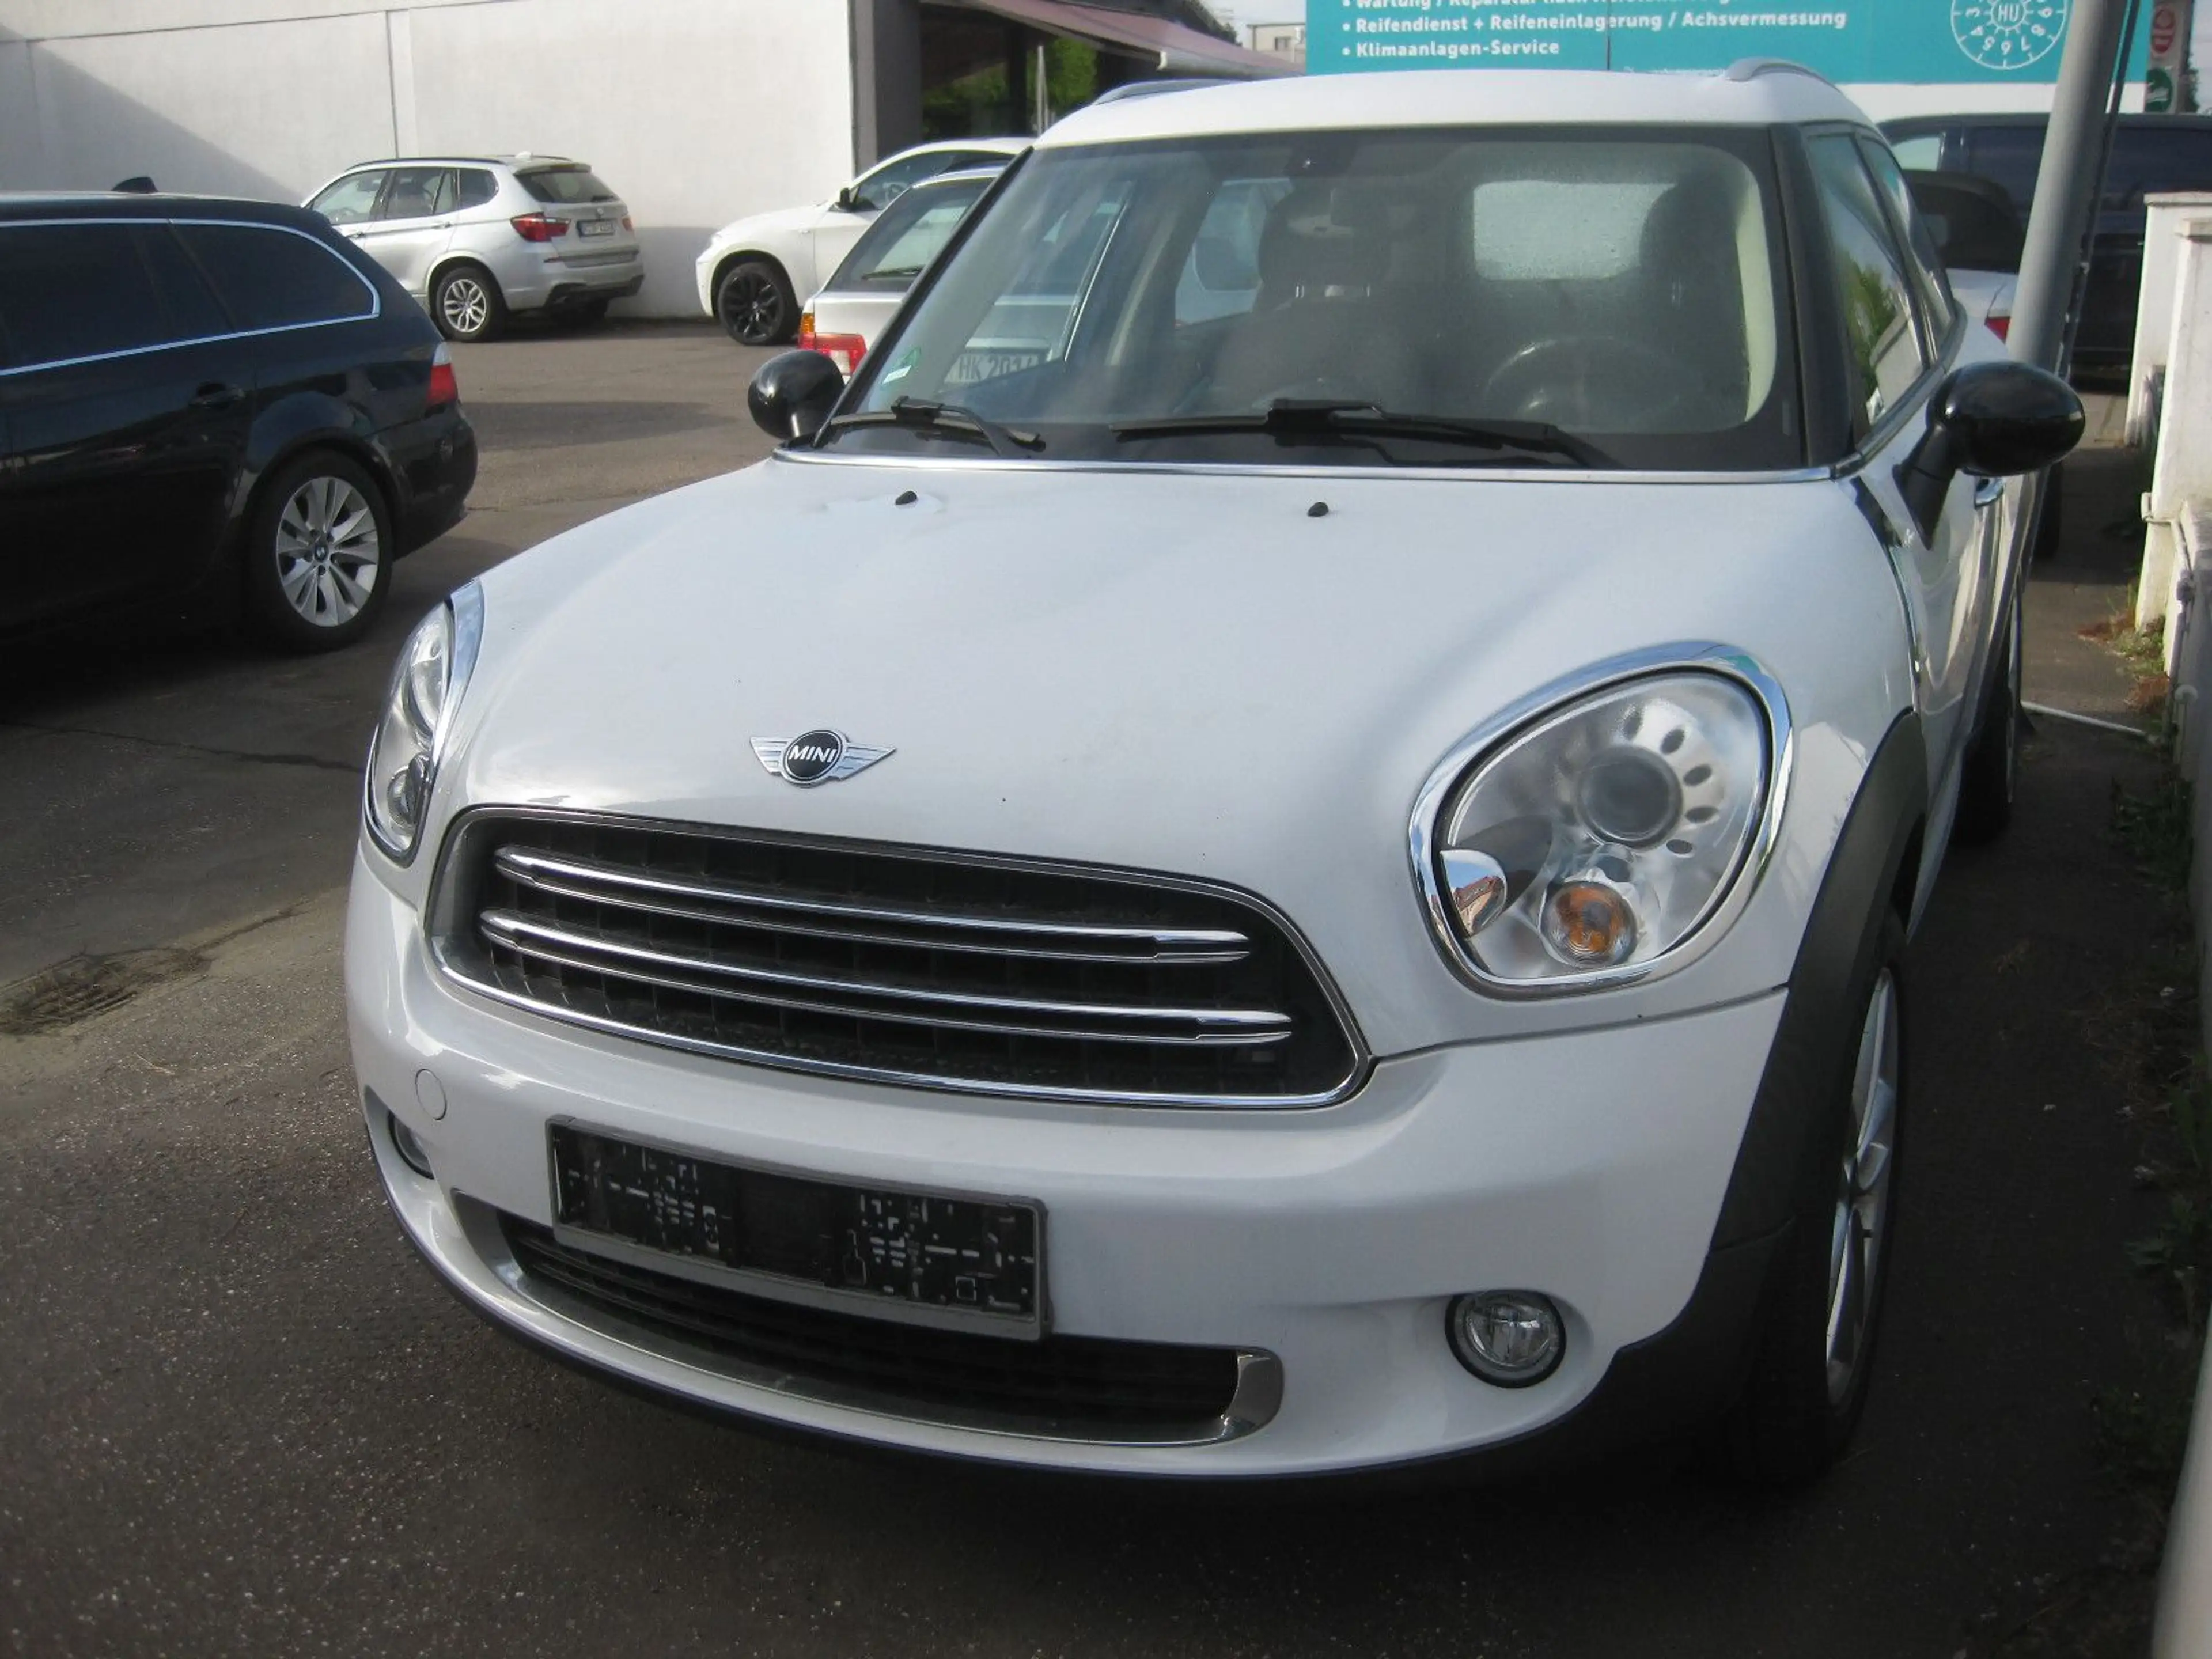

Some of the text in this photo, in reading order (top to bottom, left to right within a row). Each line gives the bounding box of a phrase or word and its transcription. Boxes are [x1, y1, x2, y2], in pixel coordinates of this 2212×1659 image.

[1356, 17, 1468, 32] Reifendienst
[1490, 13, 1662, 31] Reifeneinlagerung
[1681, 10, 1847, 29] Achsvermessung
[1997, 3, 2020, 22] HU
[1356, 39, 1560, 59] Klimaanlagen-Service
[787, 744, 838, 763] MINI
